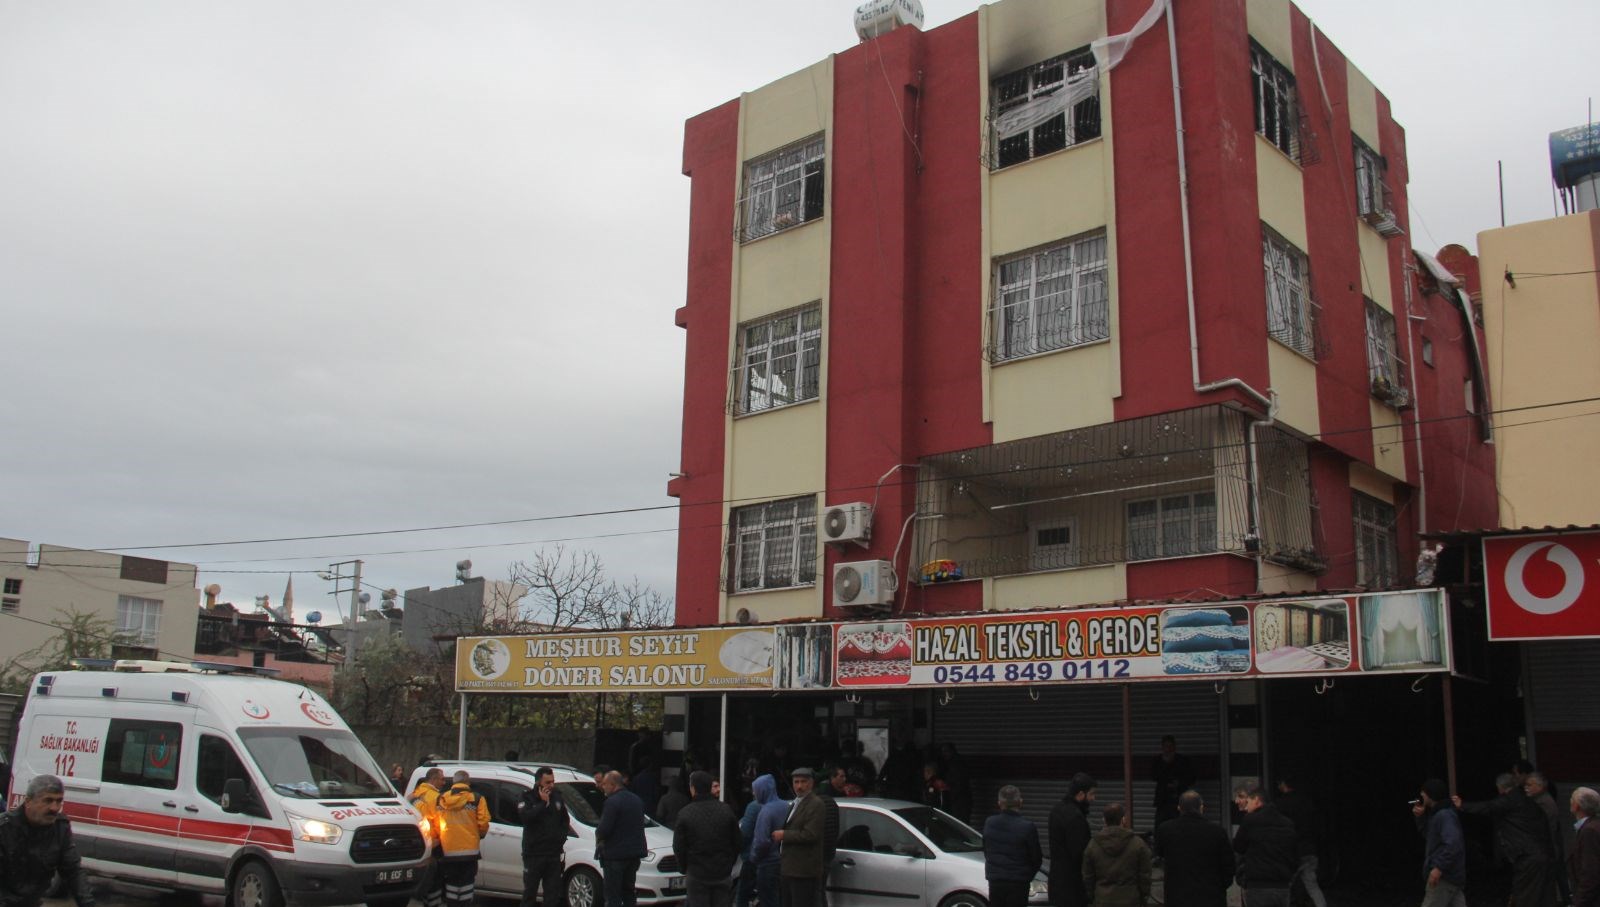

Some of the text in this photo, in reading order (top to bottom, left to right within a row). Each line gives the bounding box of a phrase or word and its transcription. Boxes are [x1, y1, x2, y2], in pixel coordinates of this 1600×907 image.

[524, 637, 623, 663] MEŞHUR
[915, 625, 980, 663] HAZAL
[1067, 619, 1083, 657] &
[1088, 614, 1159, 657] PERDE
[524, 661, 706, 686] DÖNER SALONU
[933, 659, 1130, 683] 0544 849 0112
[66, 720, 78, 735] T.C.
[40, 733, 100, 754] SAĞLIK BAKANLIĞI
[55, 753, 76, 777] 112
